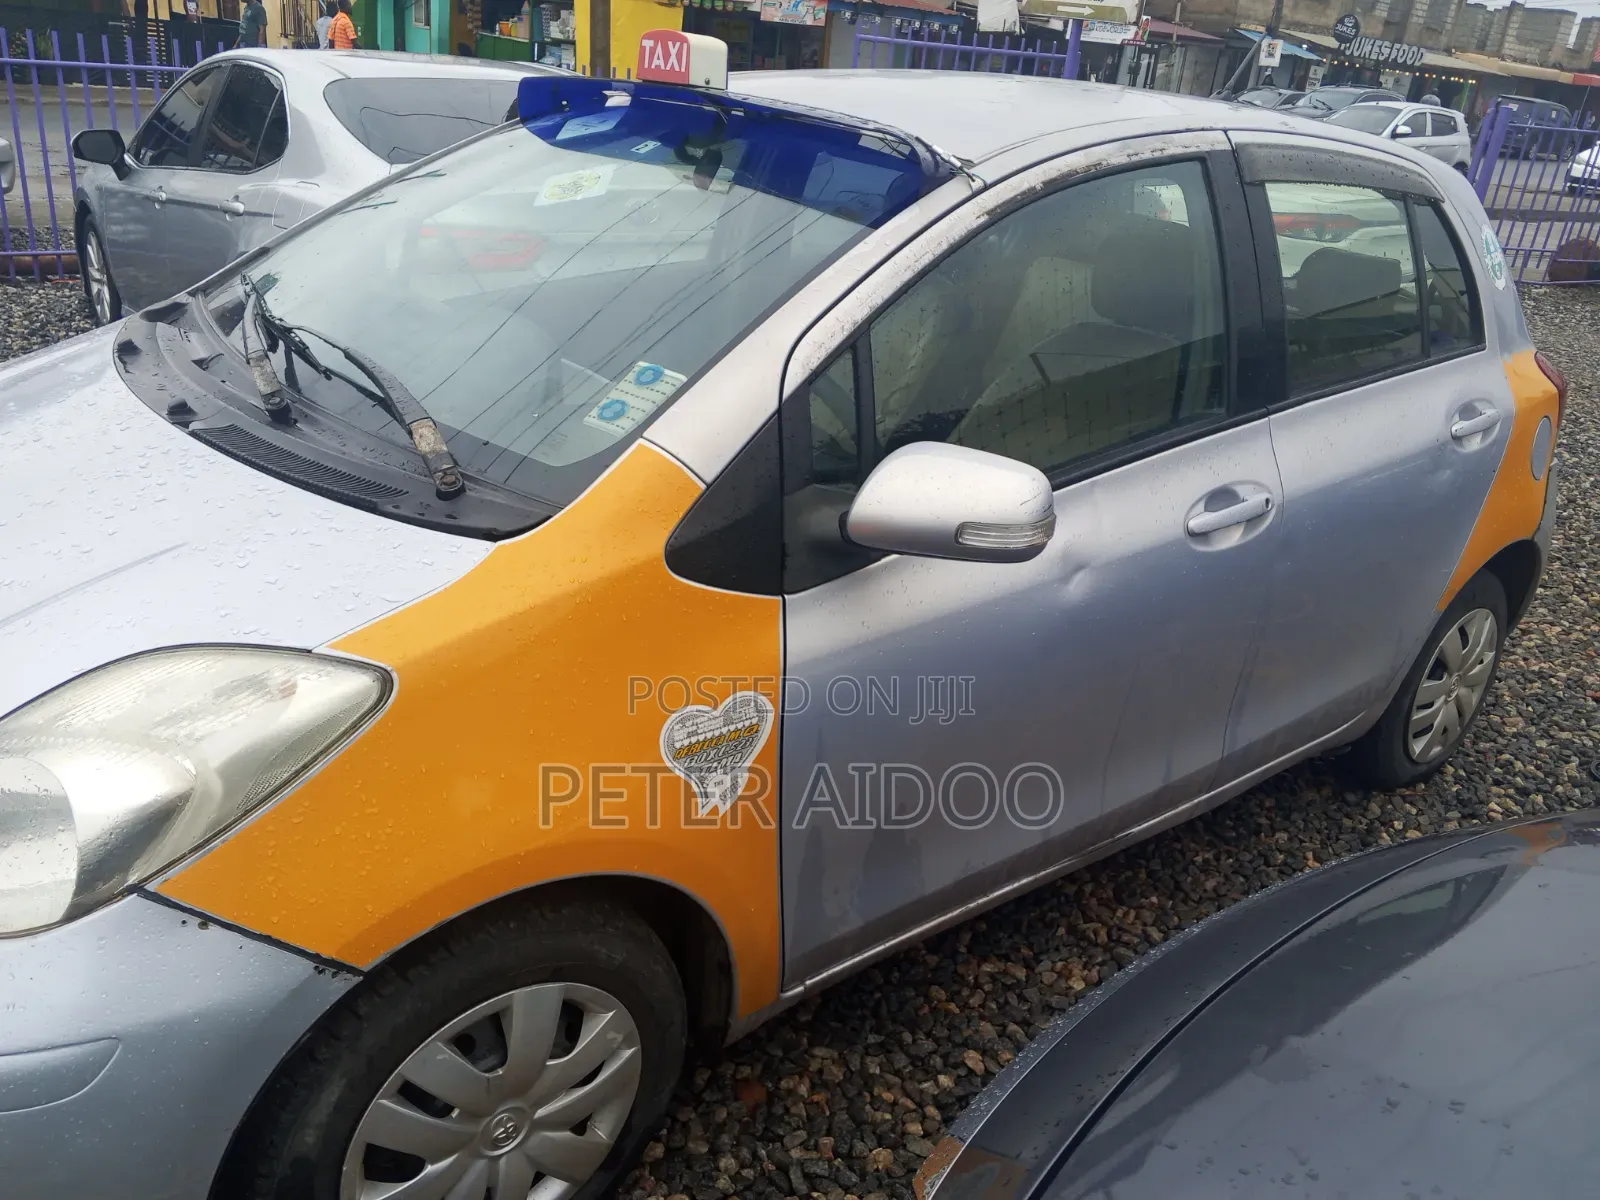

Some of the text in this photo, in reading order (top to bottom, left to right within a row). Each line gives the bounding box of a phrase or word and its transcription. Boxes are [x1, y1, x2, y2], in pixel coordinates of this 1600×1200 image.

[1335, 23, 1357, 36] JUKES
[641, 39, 687, 73] TAXI
[1345, 36, 1427, 67] JUKES FOOD
[684, 749, 718, 768] BOX
